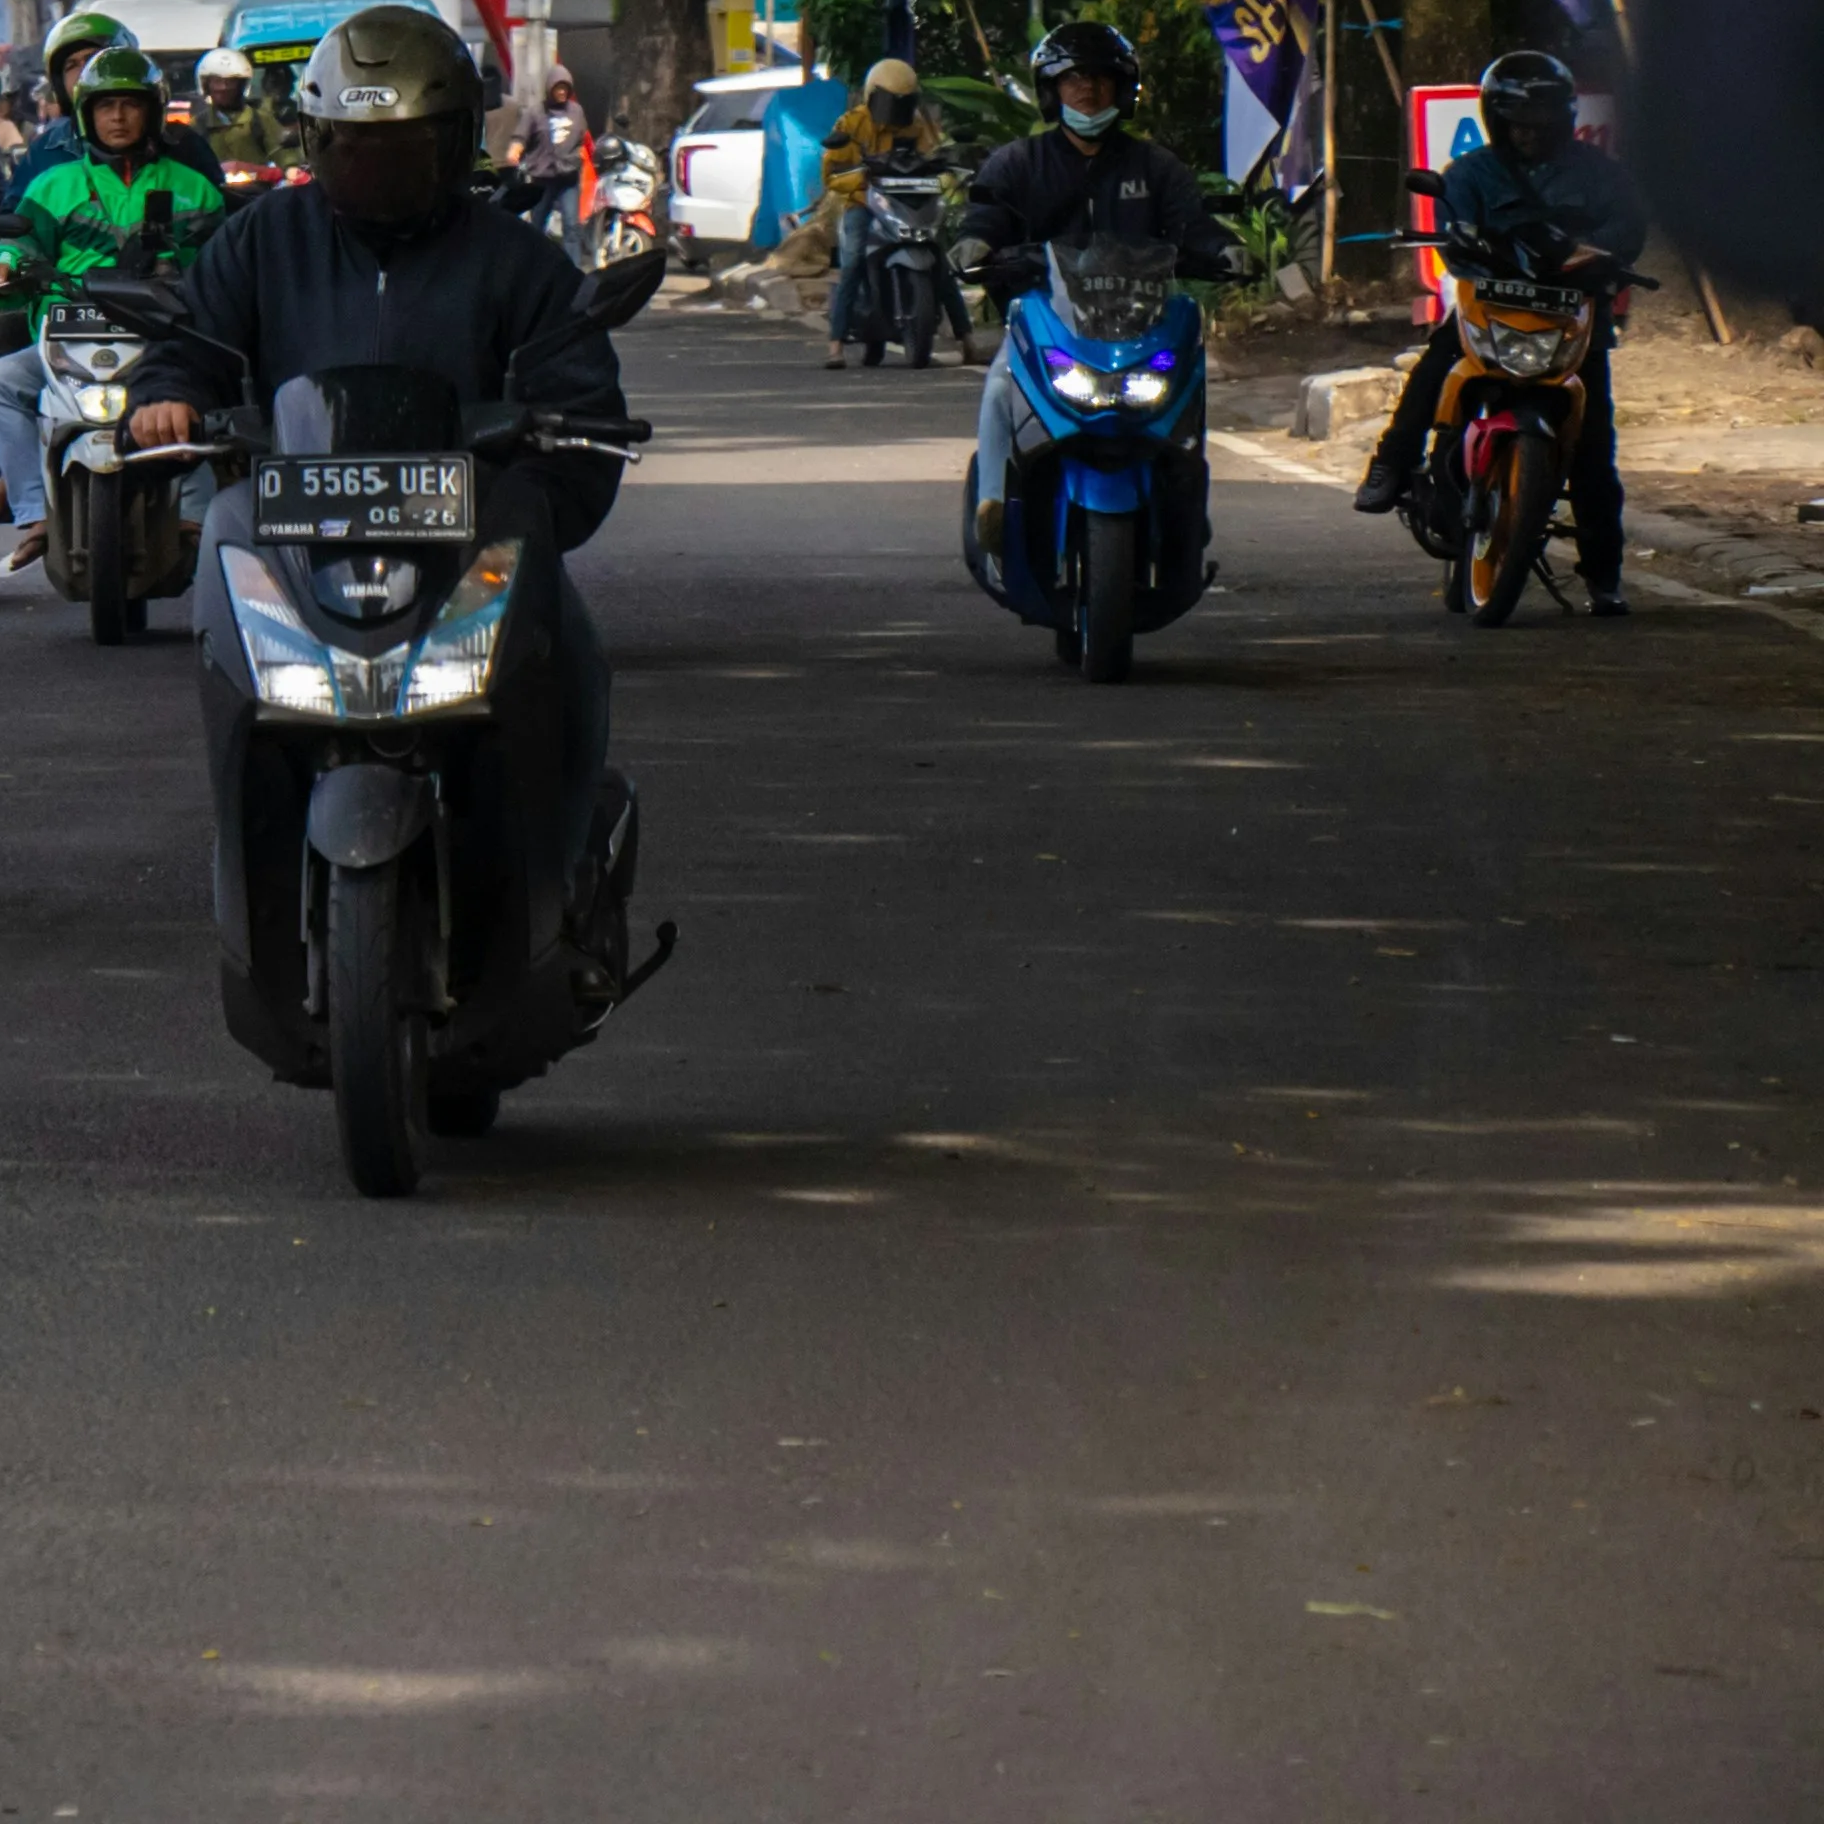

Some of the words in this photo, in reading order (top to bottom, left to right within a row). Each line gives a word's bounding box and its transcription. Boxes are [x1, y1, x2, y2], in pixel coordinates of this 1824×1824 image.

[55, 309, 67, 323] D
[263, 469, 283, 499] D
[302, 465, 382, 497] 5565
[399, 465, 459, 496] UEK
[270, 523, 315, 536] YAMAHA
[342, 584, 389, 599] YAMAHA
